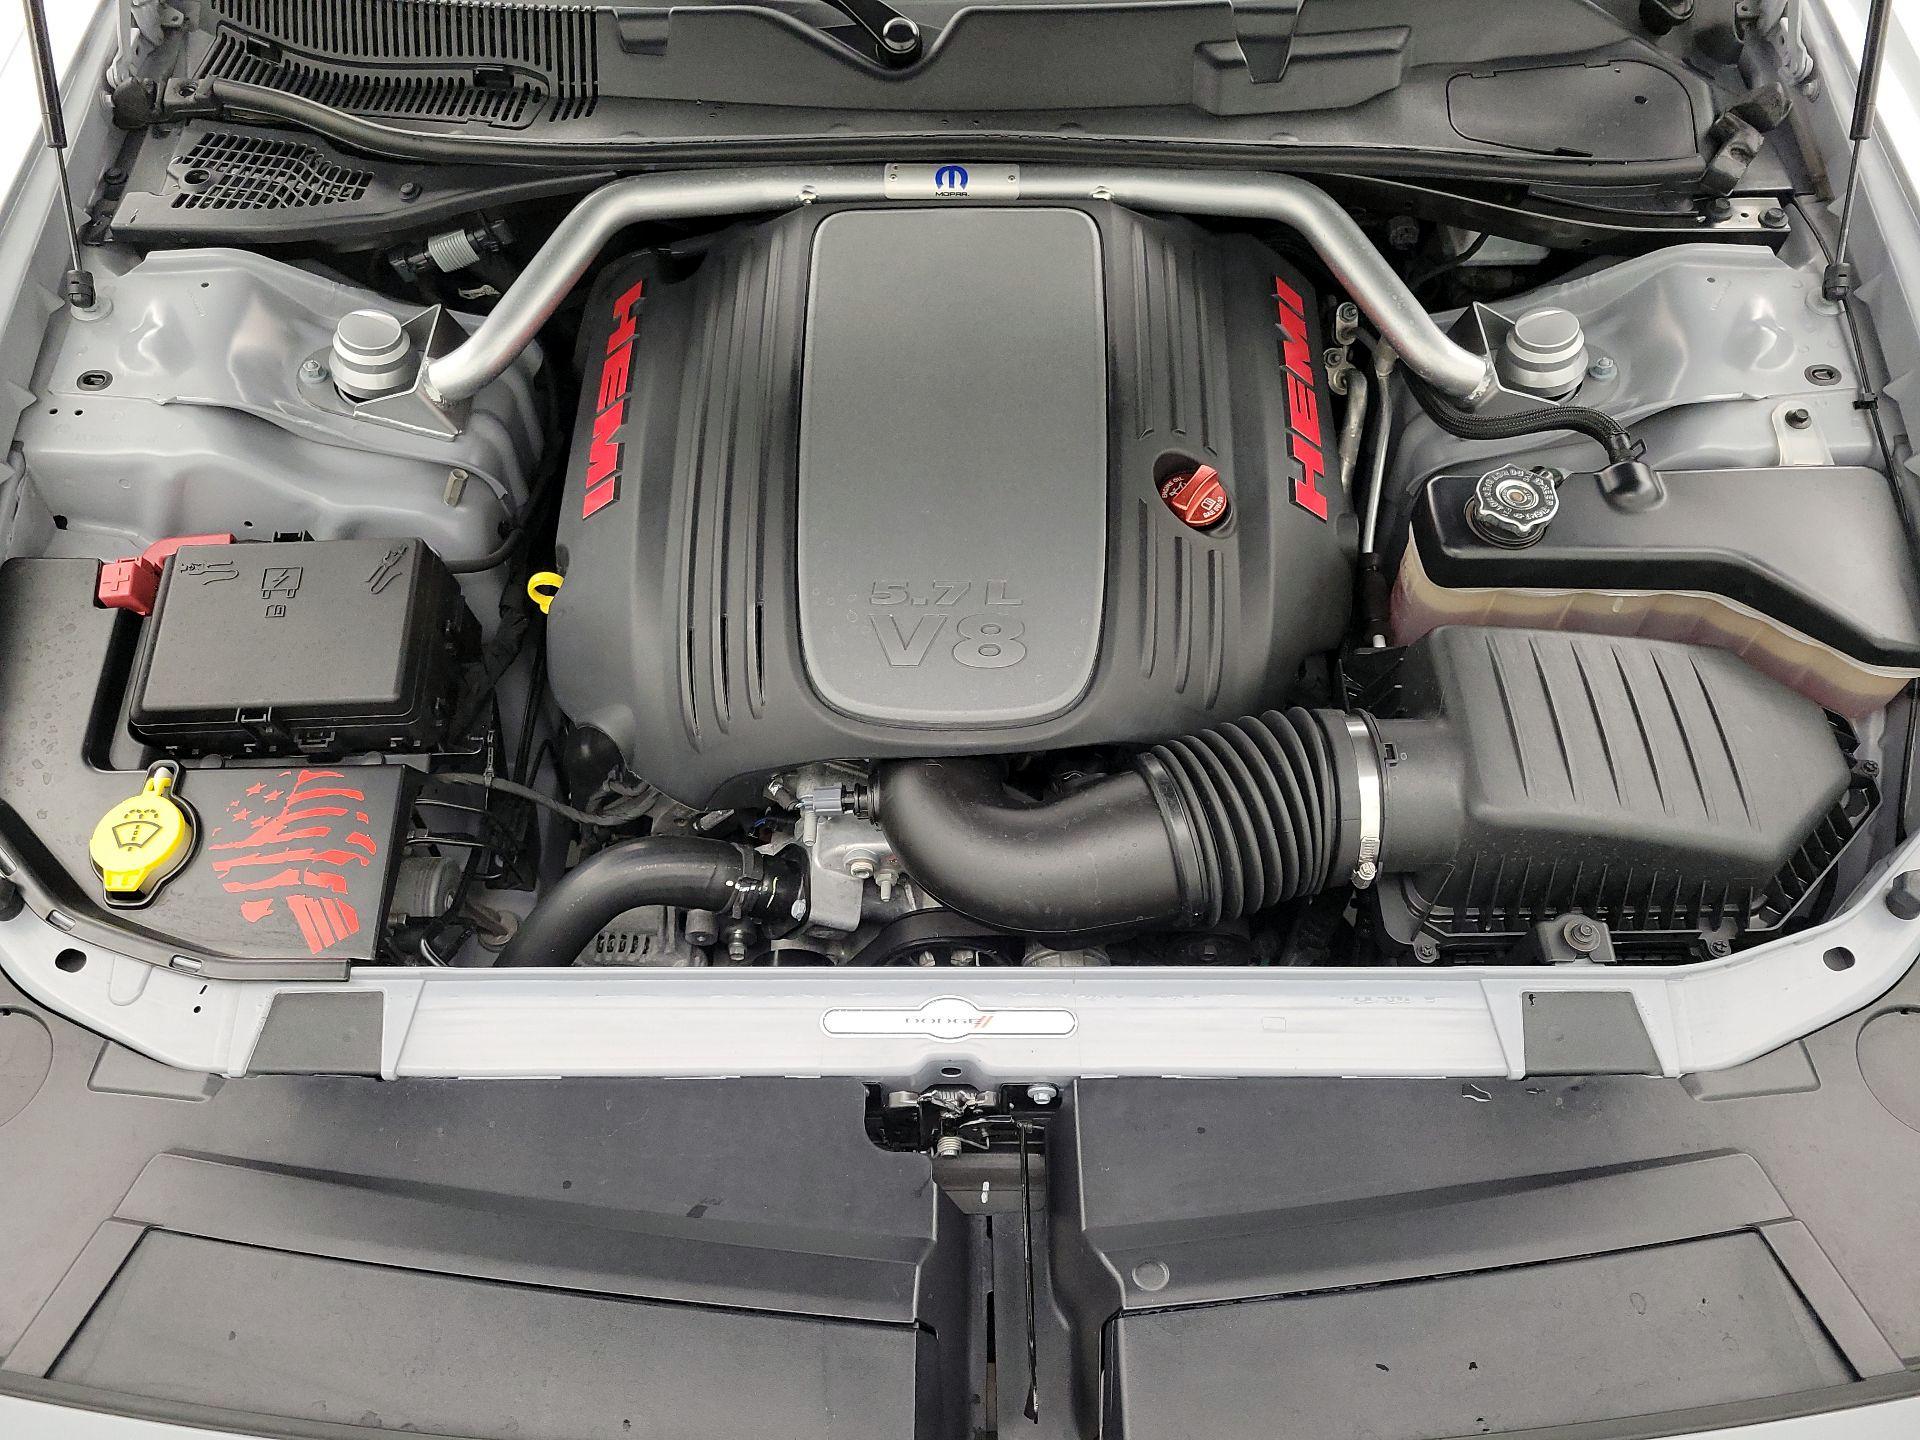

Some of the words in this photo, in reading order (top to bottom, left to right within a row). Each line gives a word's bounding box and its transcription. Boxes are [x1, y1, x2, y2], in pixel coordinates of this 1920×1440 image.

[582, 280, 643, 520] HEMI
[1275, 275, 1328, 522] HEMI
[868, 613, 1028, 669] V8
